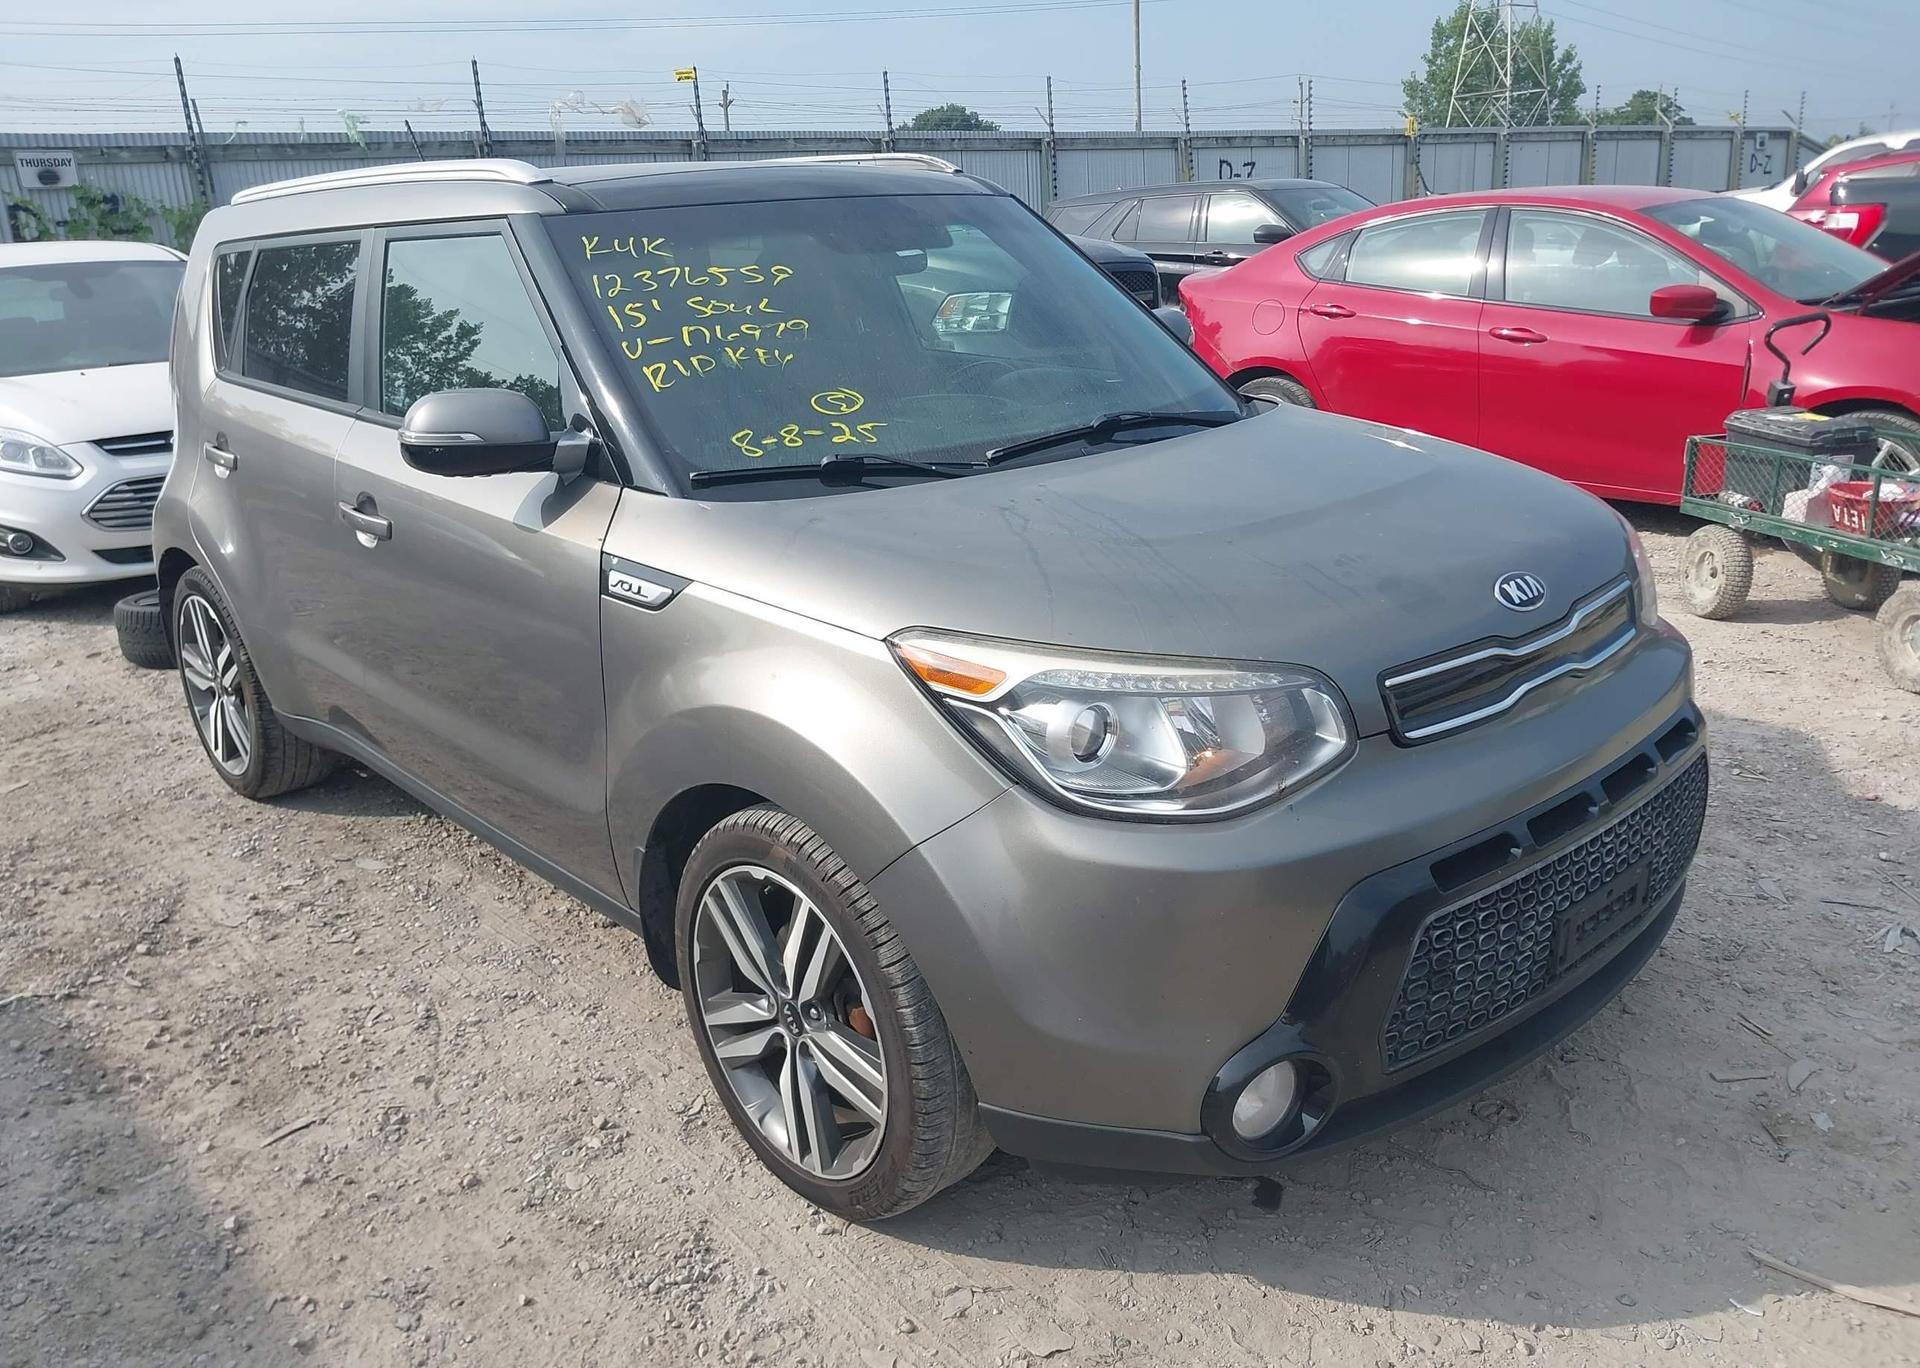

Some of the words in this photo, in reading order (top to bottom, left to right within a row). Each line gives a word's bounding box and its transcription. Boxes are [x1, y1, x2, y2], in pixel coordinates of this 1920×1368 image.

[18, 158, 72, 168] THURSDAY
[731, 422, 888, 457] 8-8-25
[1501, 575, 1544, 604] KIA
